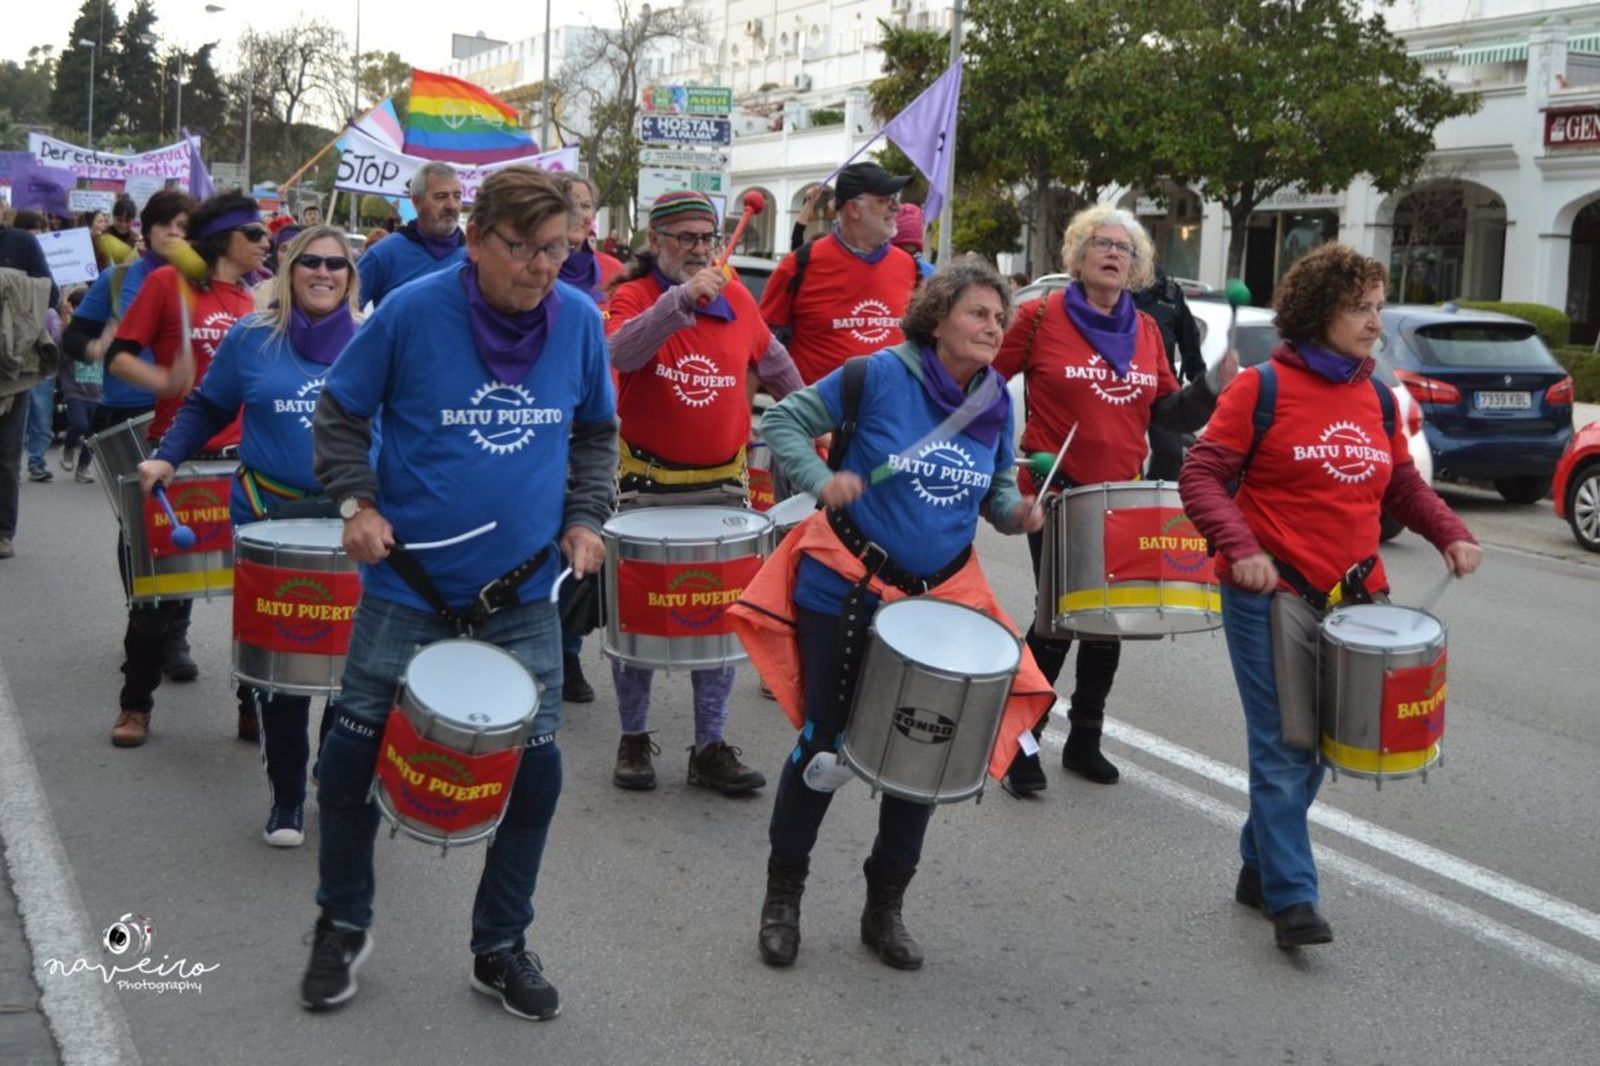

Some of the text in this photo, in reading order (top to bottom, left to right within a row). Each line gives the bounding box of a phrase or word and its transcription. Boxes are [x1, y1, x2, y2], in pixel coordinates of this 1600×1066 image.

[657, 117, 719, 133] HOSTAL
[40, 141, 127, 168] Derechos
[336, 150, 400, 188] STOP
[831, 316, 903, 330] BATU PUERT
[191, 327, 221, 340] ATU
[655, 363, 737, 388] BATU PUERTO
[1065, 365, 1107, 381] BATU
[274, 399, 316, 413] BATU
[441, 408, 563, 426] BATU PUERTO
[1293, 445, 1340, 461] BATU
[888, 454, 937, 477] BATU
[1138, 536, 1208, 553] BATU PUE
[256, 597, 294, 618] BATU
[647, 592, 688, 608] BATU
[387, 743, 503, 802] BATU PUERTO
